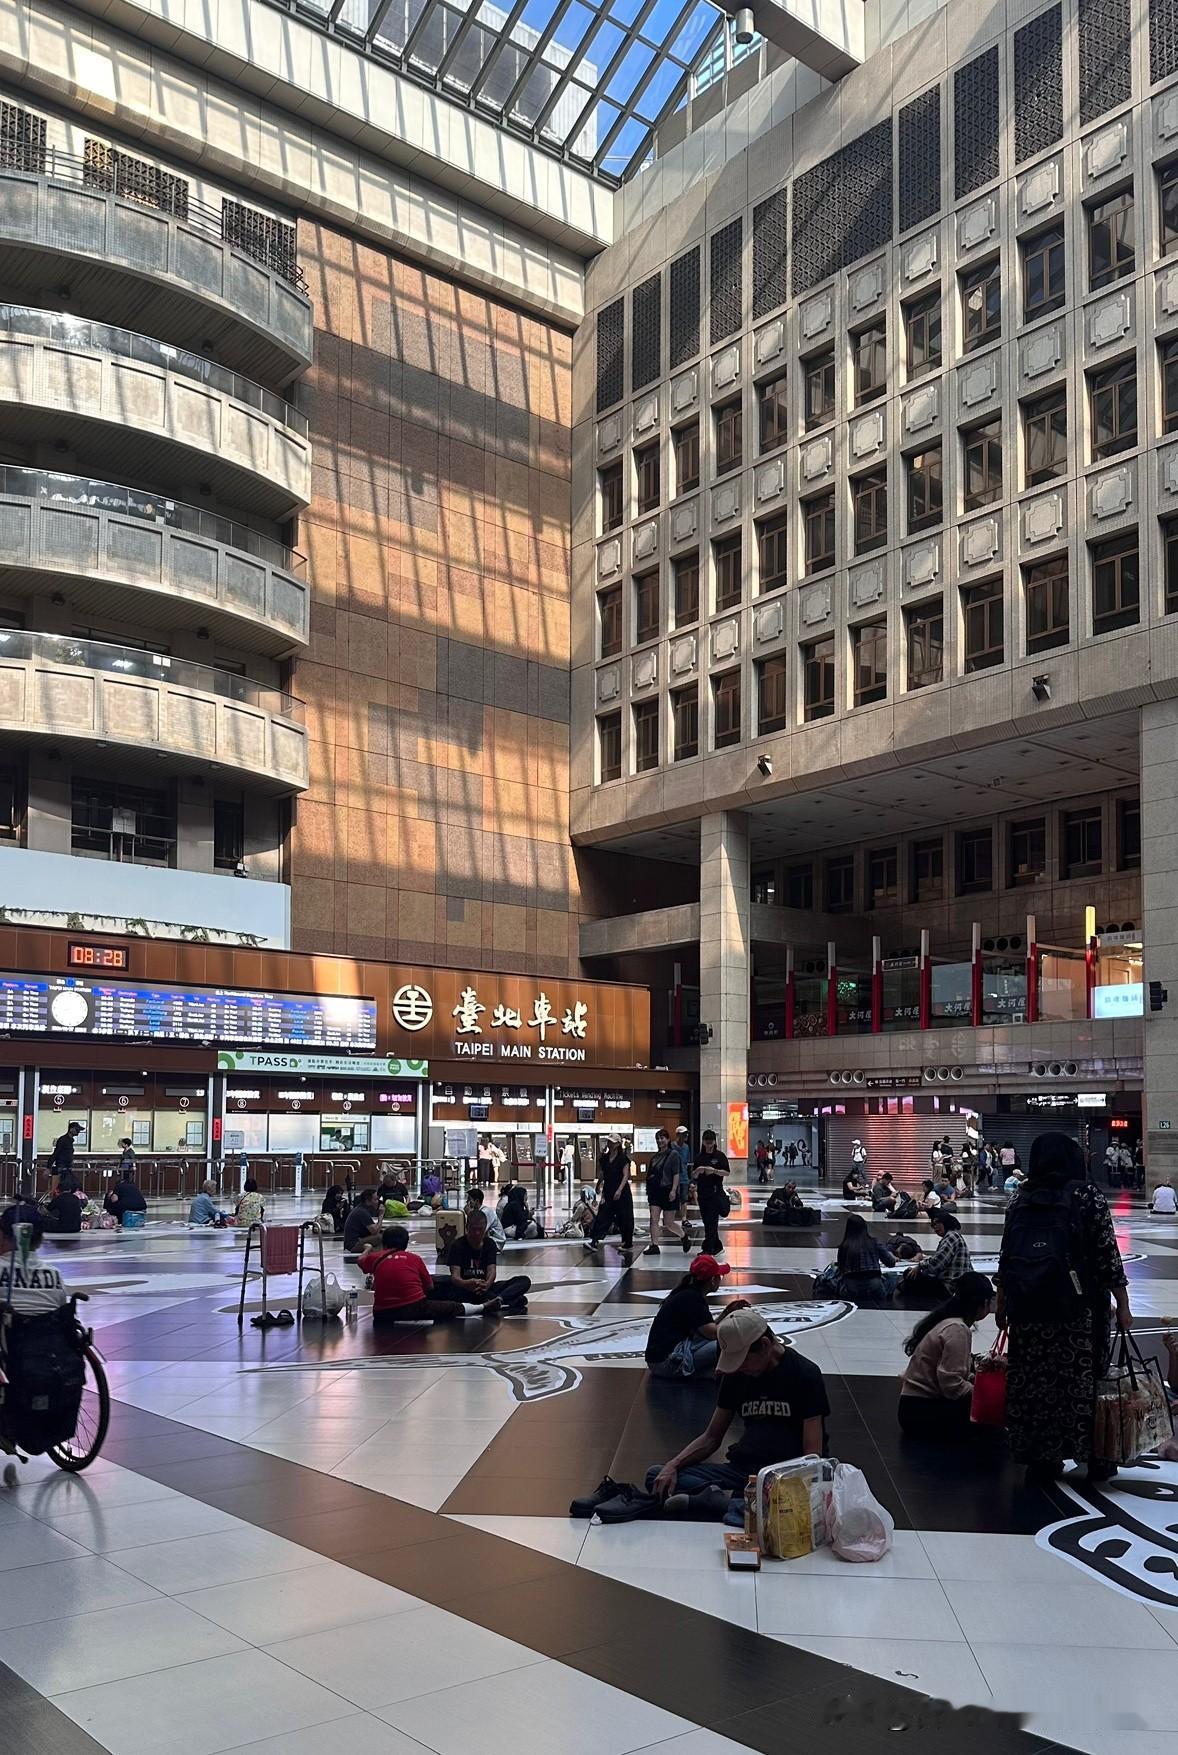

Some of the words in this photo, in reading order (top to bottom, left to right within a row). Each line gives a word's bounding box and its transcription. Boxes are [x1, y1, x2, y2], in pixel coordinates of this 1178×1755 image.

[73, 946, 122, 966] 08:28
[452, 986, 588, 1041] 臺北車站
[455, 1042, 494, 1056] TAIPEI
[502, 1045, 531, 1057] MAIN
[538, 1046, 585, 1060] STATION
[250, 1056, 287, 1066] TPASS
